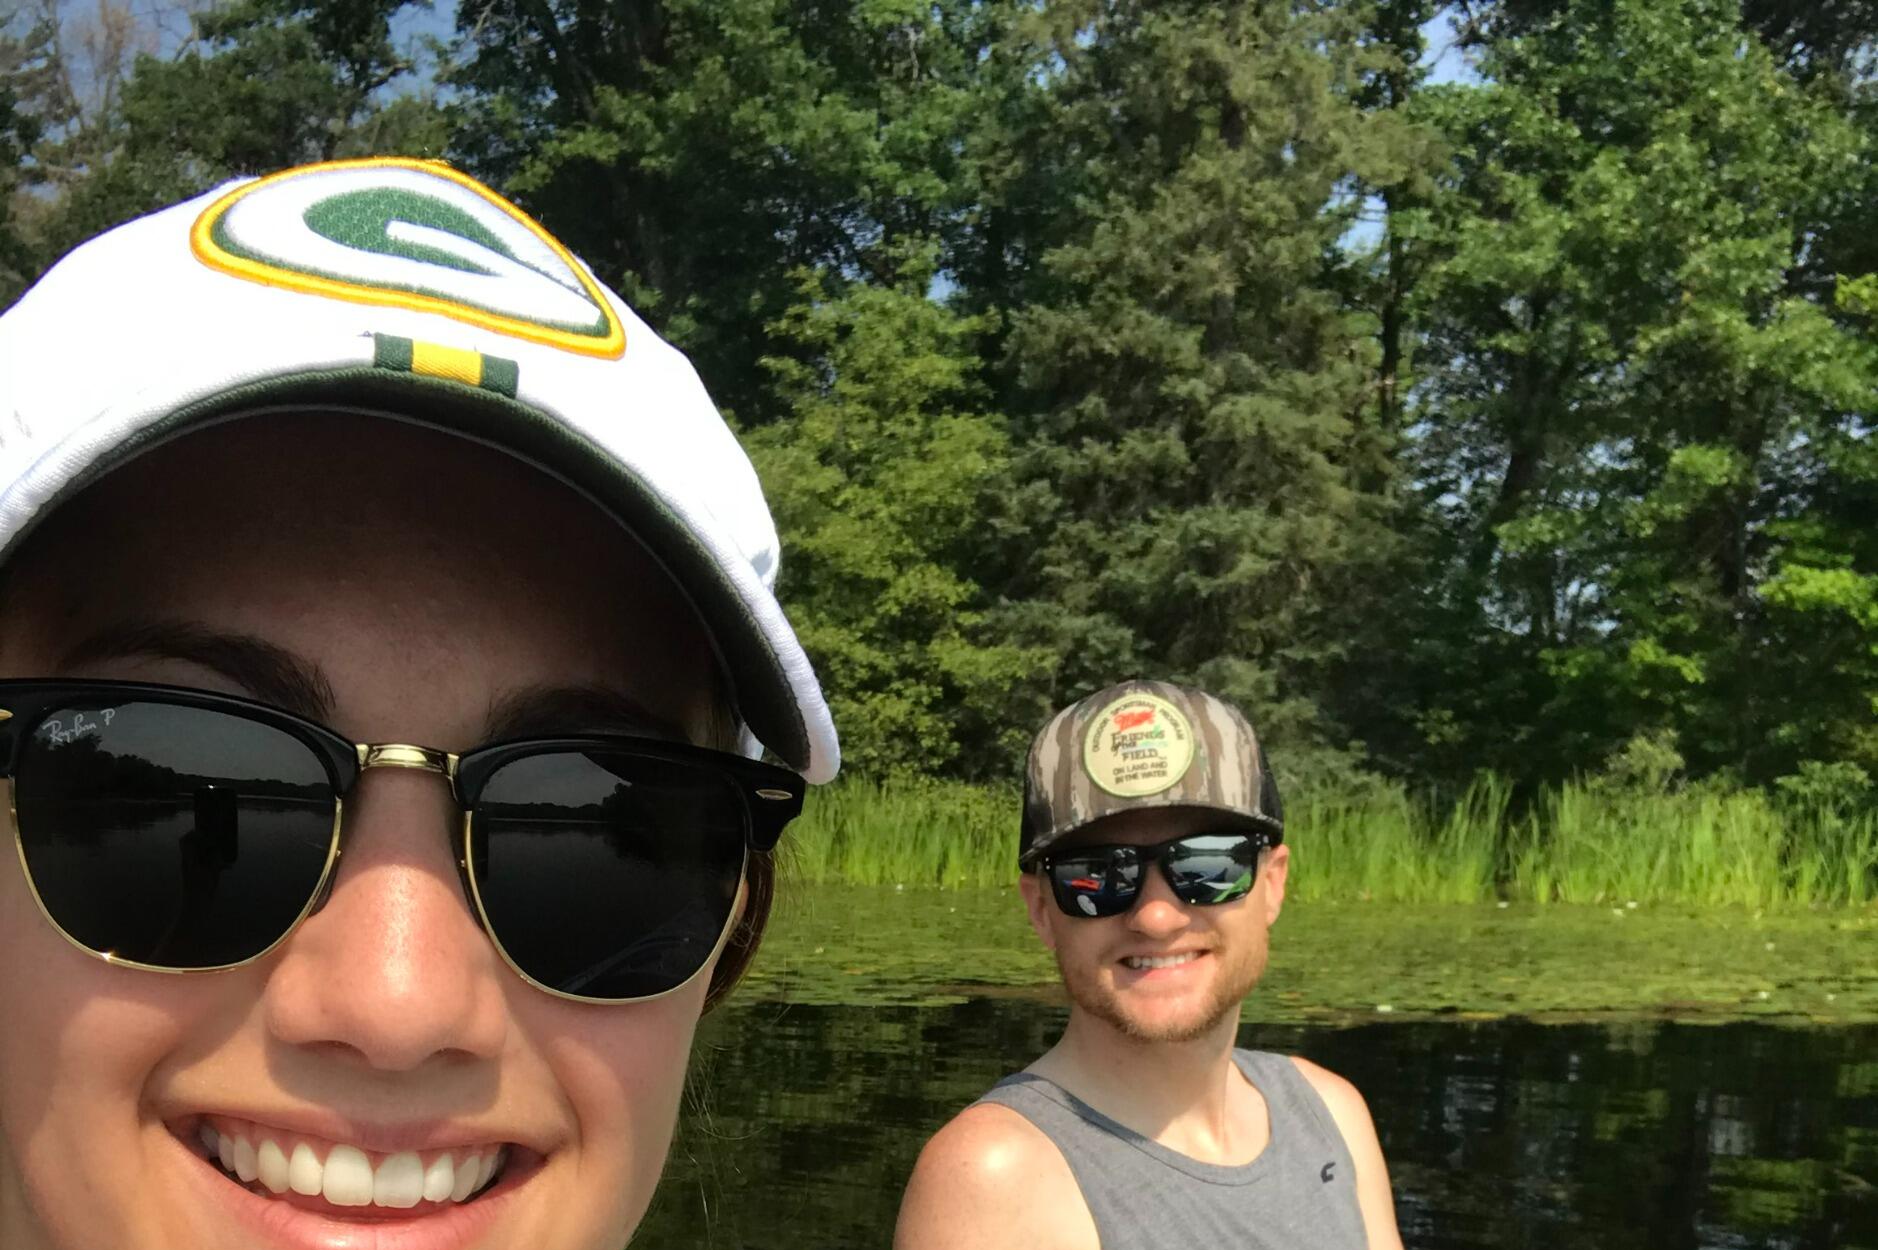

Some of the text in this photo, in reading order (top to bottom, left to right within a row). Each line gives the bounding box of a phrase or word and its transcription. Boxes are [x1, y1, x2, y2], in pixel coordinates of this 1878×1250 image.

[42, 713, 97, 743] Ray-Ban
[1121, 748, 1158, 761] FIELD
[1112, 761, 1168, 776] ON LAND AND
[1114, 770, 1168, 784] IN THE WATER
